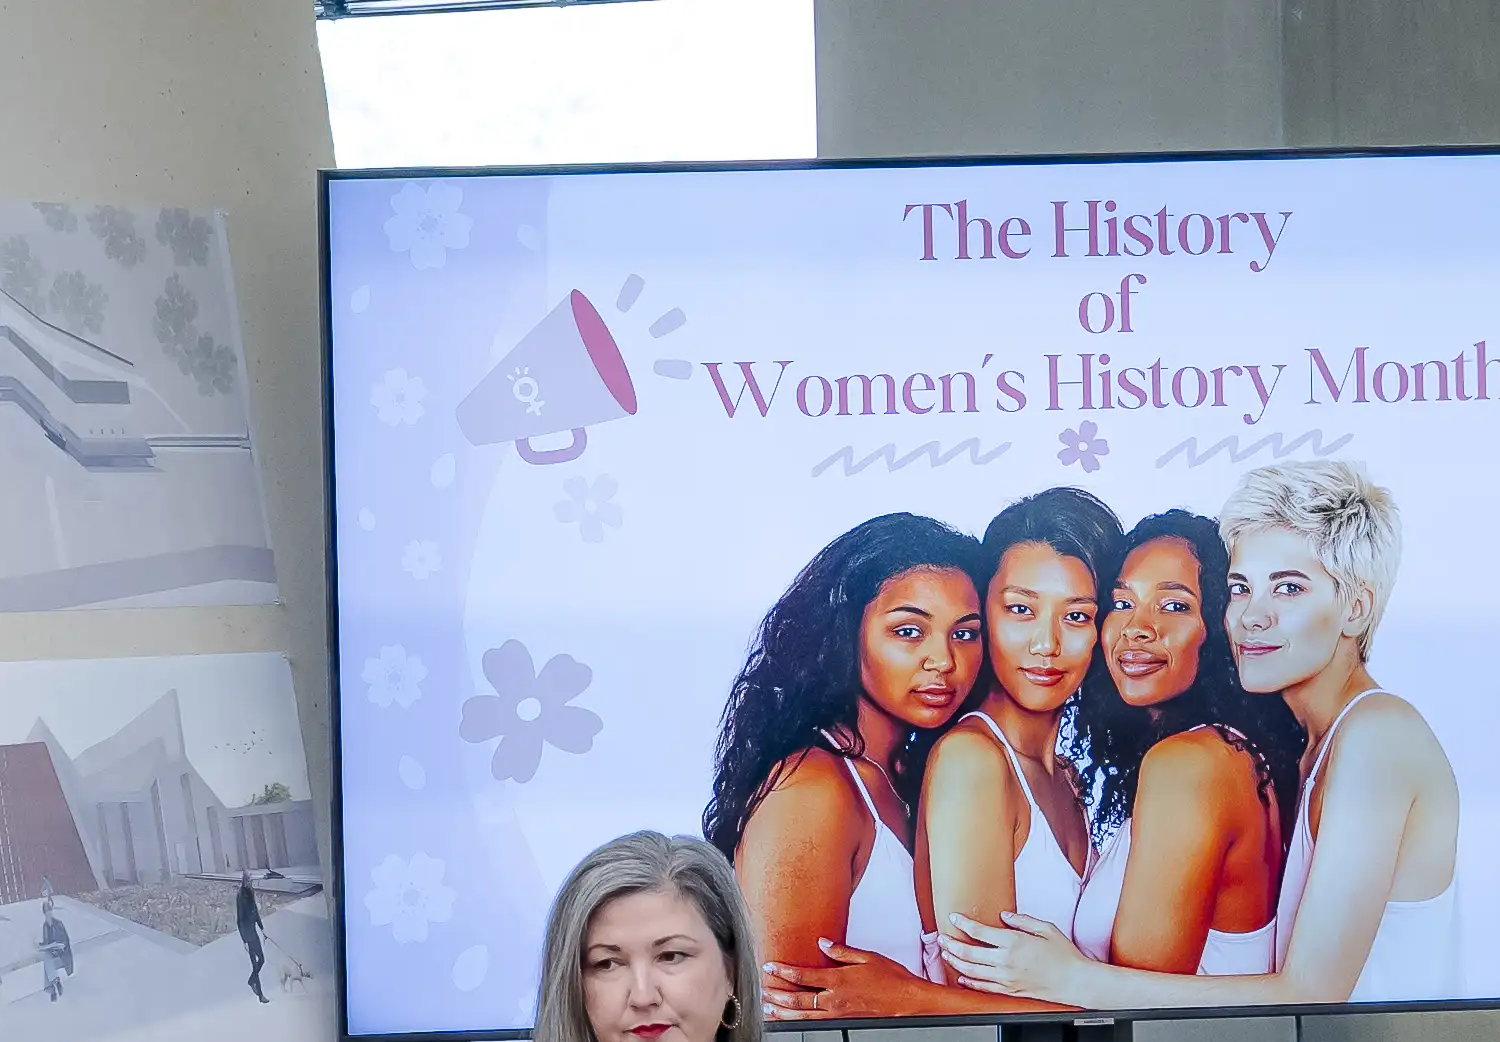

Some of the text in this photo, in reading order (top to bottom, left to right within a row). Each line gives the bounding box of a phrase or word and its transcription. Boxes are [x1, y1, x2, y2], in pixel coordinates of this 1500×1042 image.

[903, 199, 1293, 272] The History
[1078, 273, 1148, 335] of
[701, 353, 1027, 418] Women's
[1044, 353, 1287, 424] History
